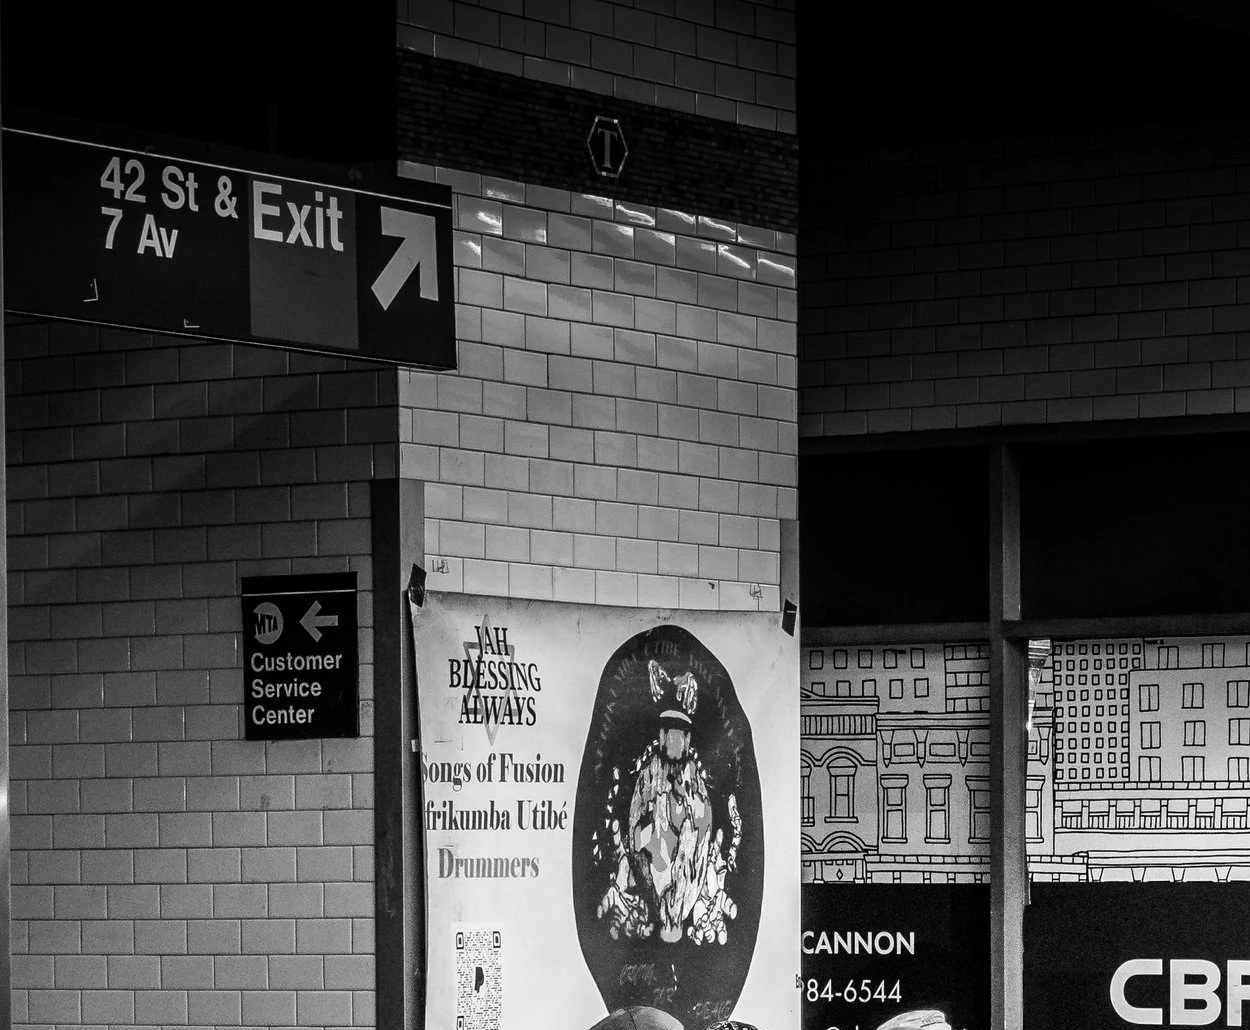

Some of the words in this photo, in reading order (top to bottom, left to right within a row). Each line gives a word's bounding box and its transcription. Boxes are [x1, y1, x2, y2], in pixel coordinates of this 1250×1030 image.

[100, 156, 146, 203] 42
[161, 165, 199, 212] St
[214, 175, 239, 219] &
[252, 180, 344, 252] Exit
[101, 206, 123, 249] 7
[137, 214, 178, 259] Av
[253, 612, 279, 636] MTA
[474, 625, 510, 658] JAH
[250, 652, 343, 672] Customer
[448, 658, 541, 692] BLESSING
[251, 677, 322, 698] Service
[252, 704, 315, 725] Center
[458, 694, 537, 726] ALWAYS
[476, 752, 497, 783] of
[499, 752, 565, 783] Fusion
[425, 800, 511, 830] frikumba
[517, 800, 568, 830] Utibé
[437, 848, 540, 879] Drummers
[801, 930, 915, 955] CANNON
